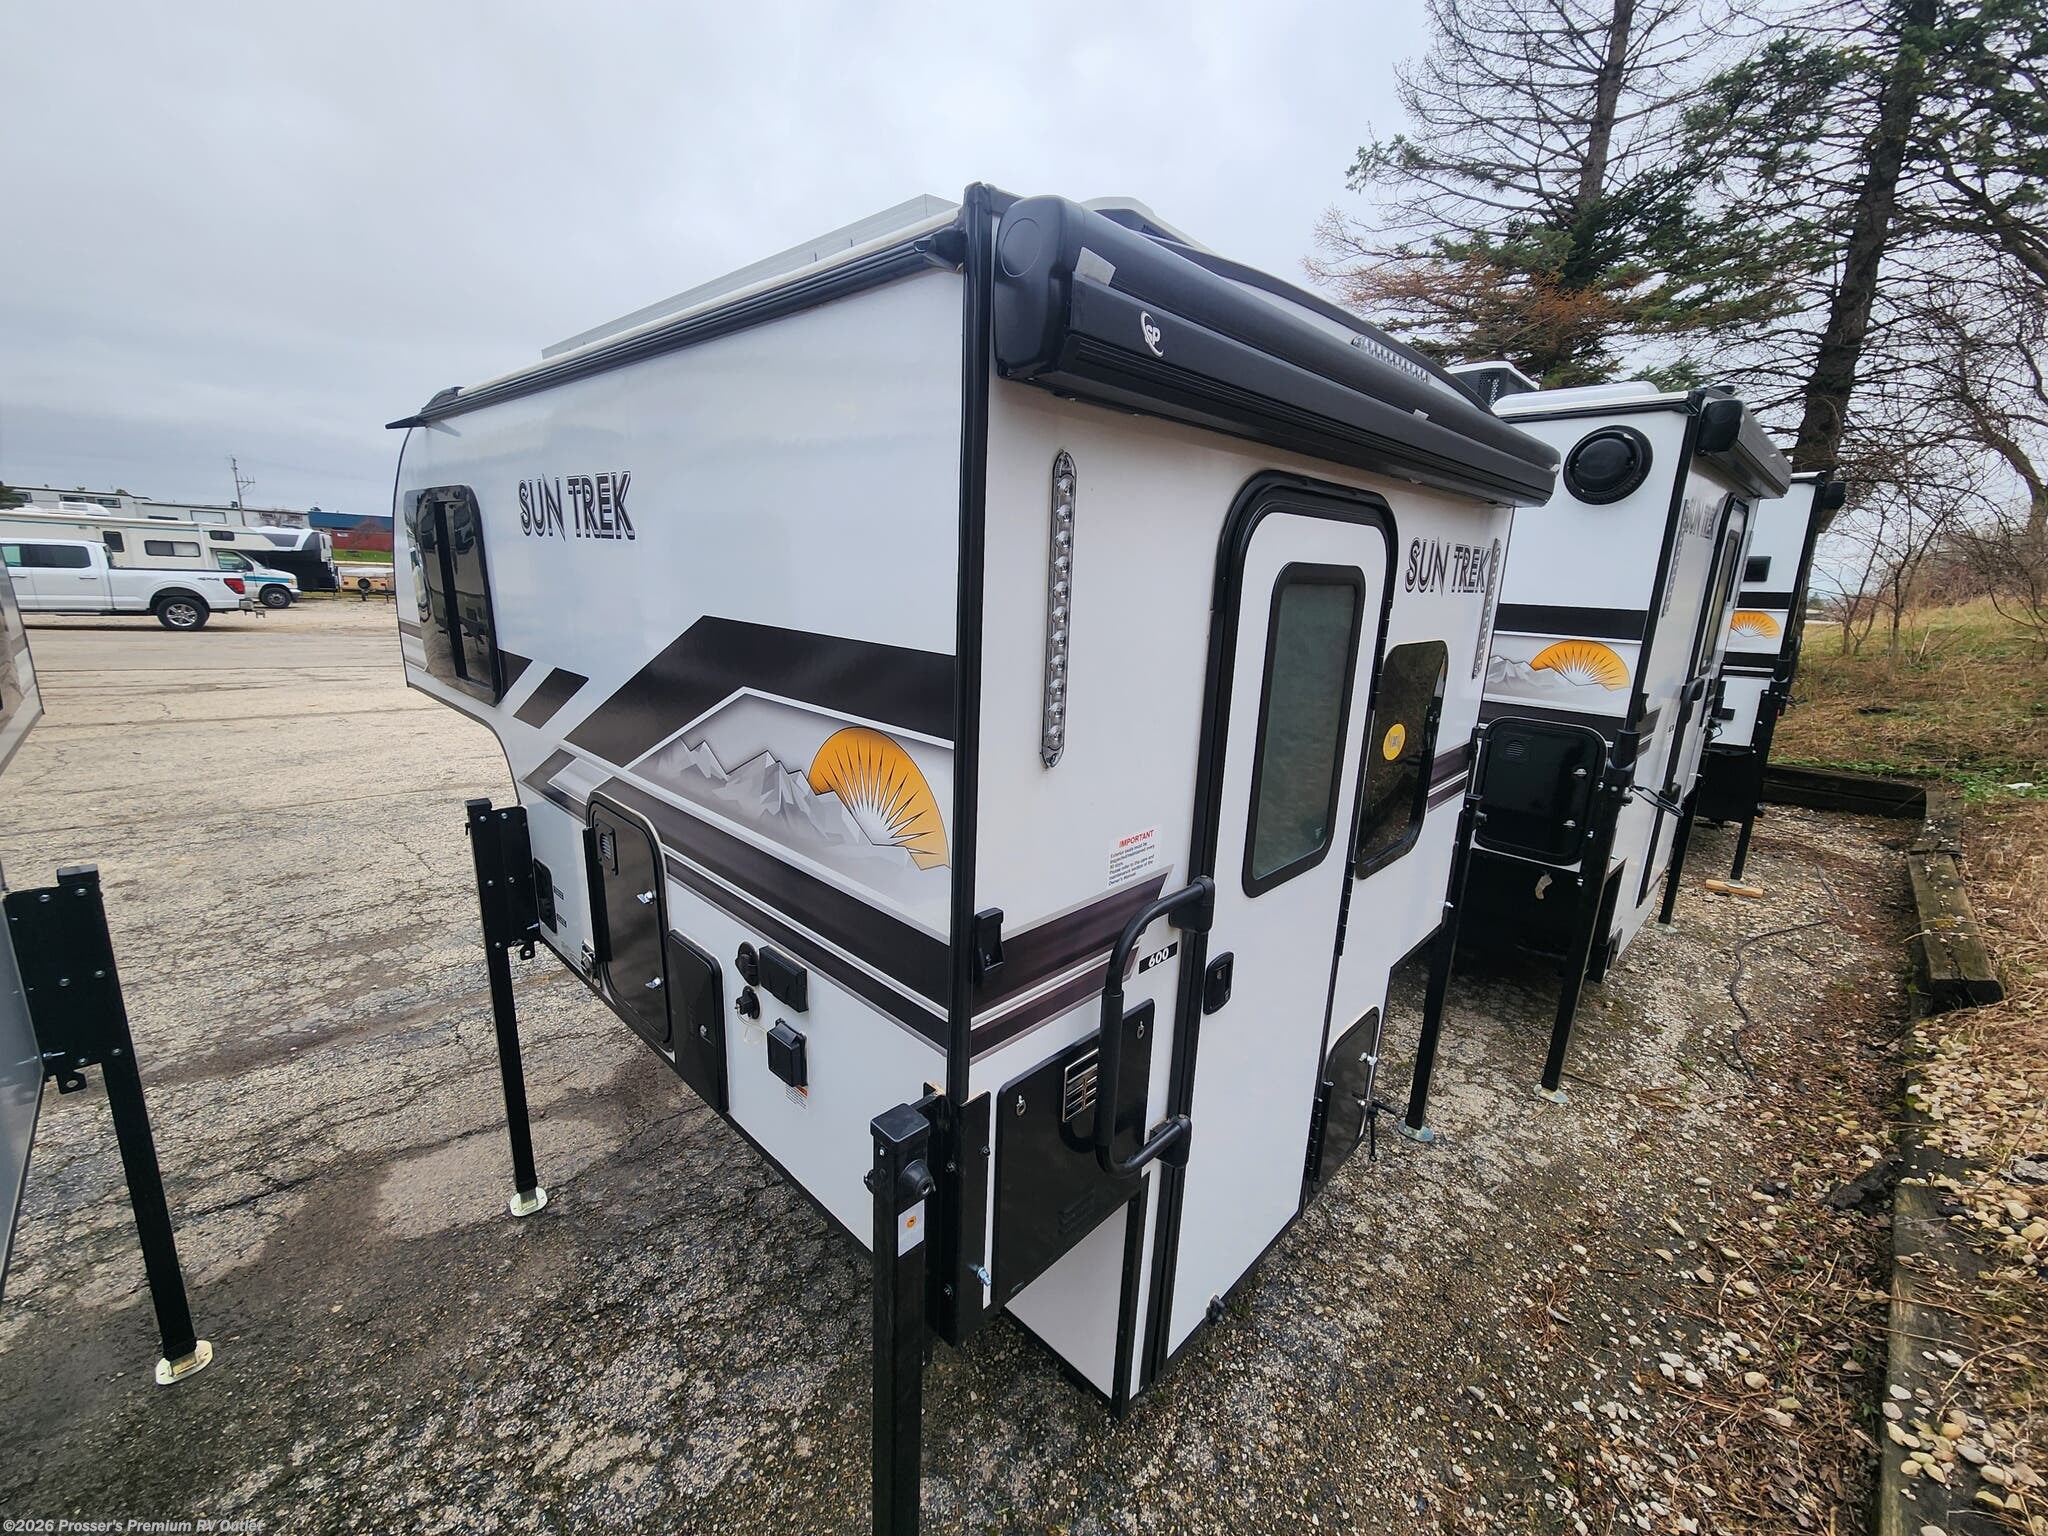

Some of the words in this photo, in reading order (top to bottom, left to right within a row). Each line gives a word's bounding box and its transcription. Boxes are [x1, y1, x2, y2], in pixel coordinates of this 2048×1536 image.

[518, 473, 566, 542] SUN
[566, 470, 636, 541] TREK
[1404, 536, 1451, 597] SUN
[1451, 543, 1492, 594] TREK
[1118, 829, 1155, 849] IMPORTANT
[1148, 947, 1170, 968] 600
